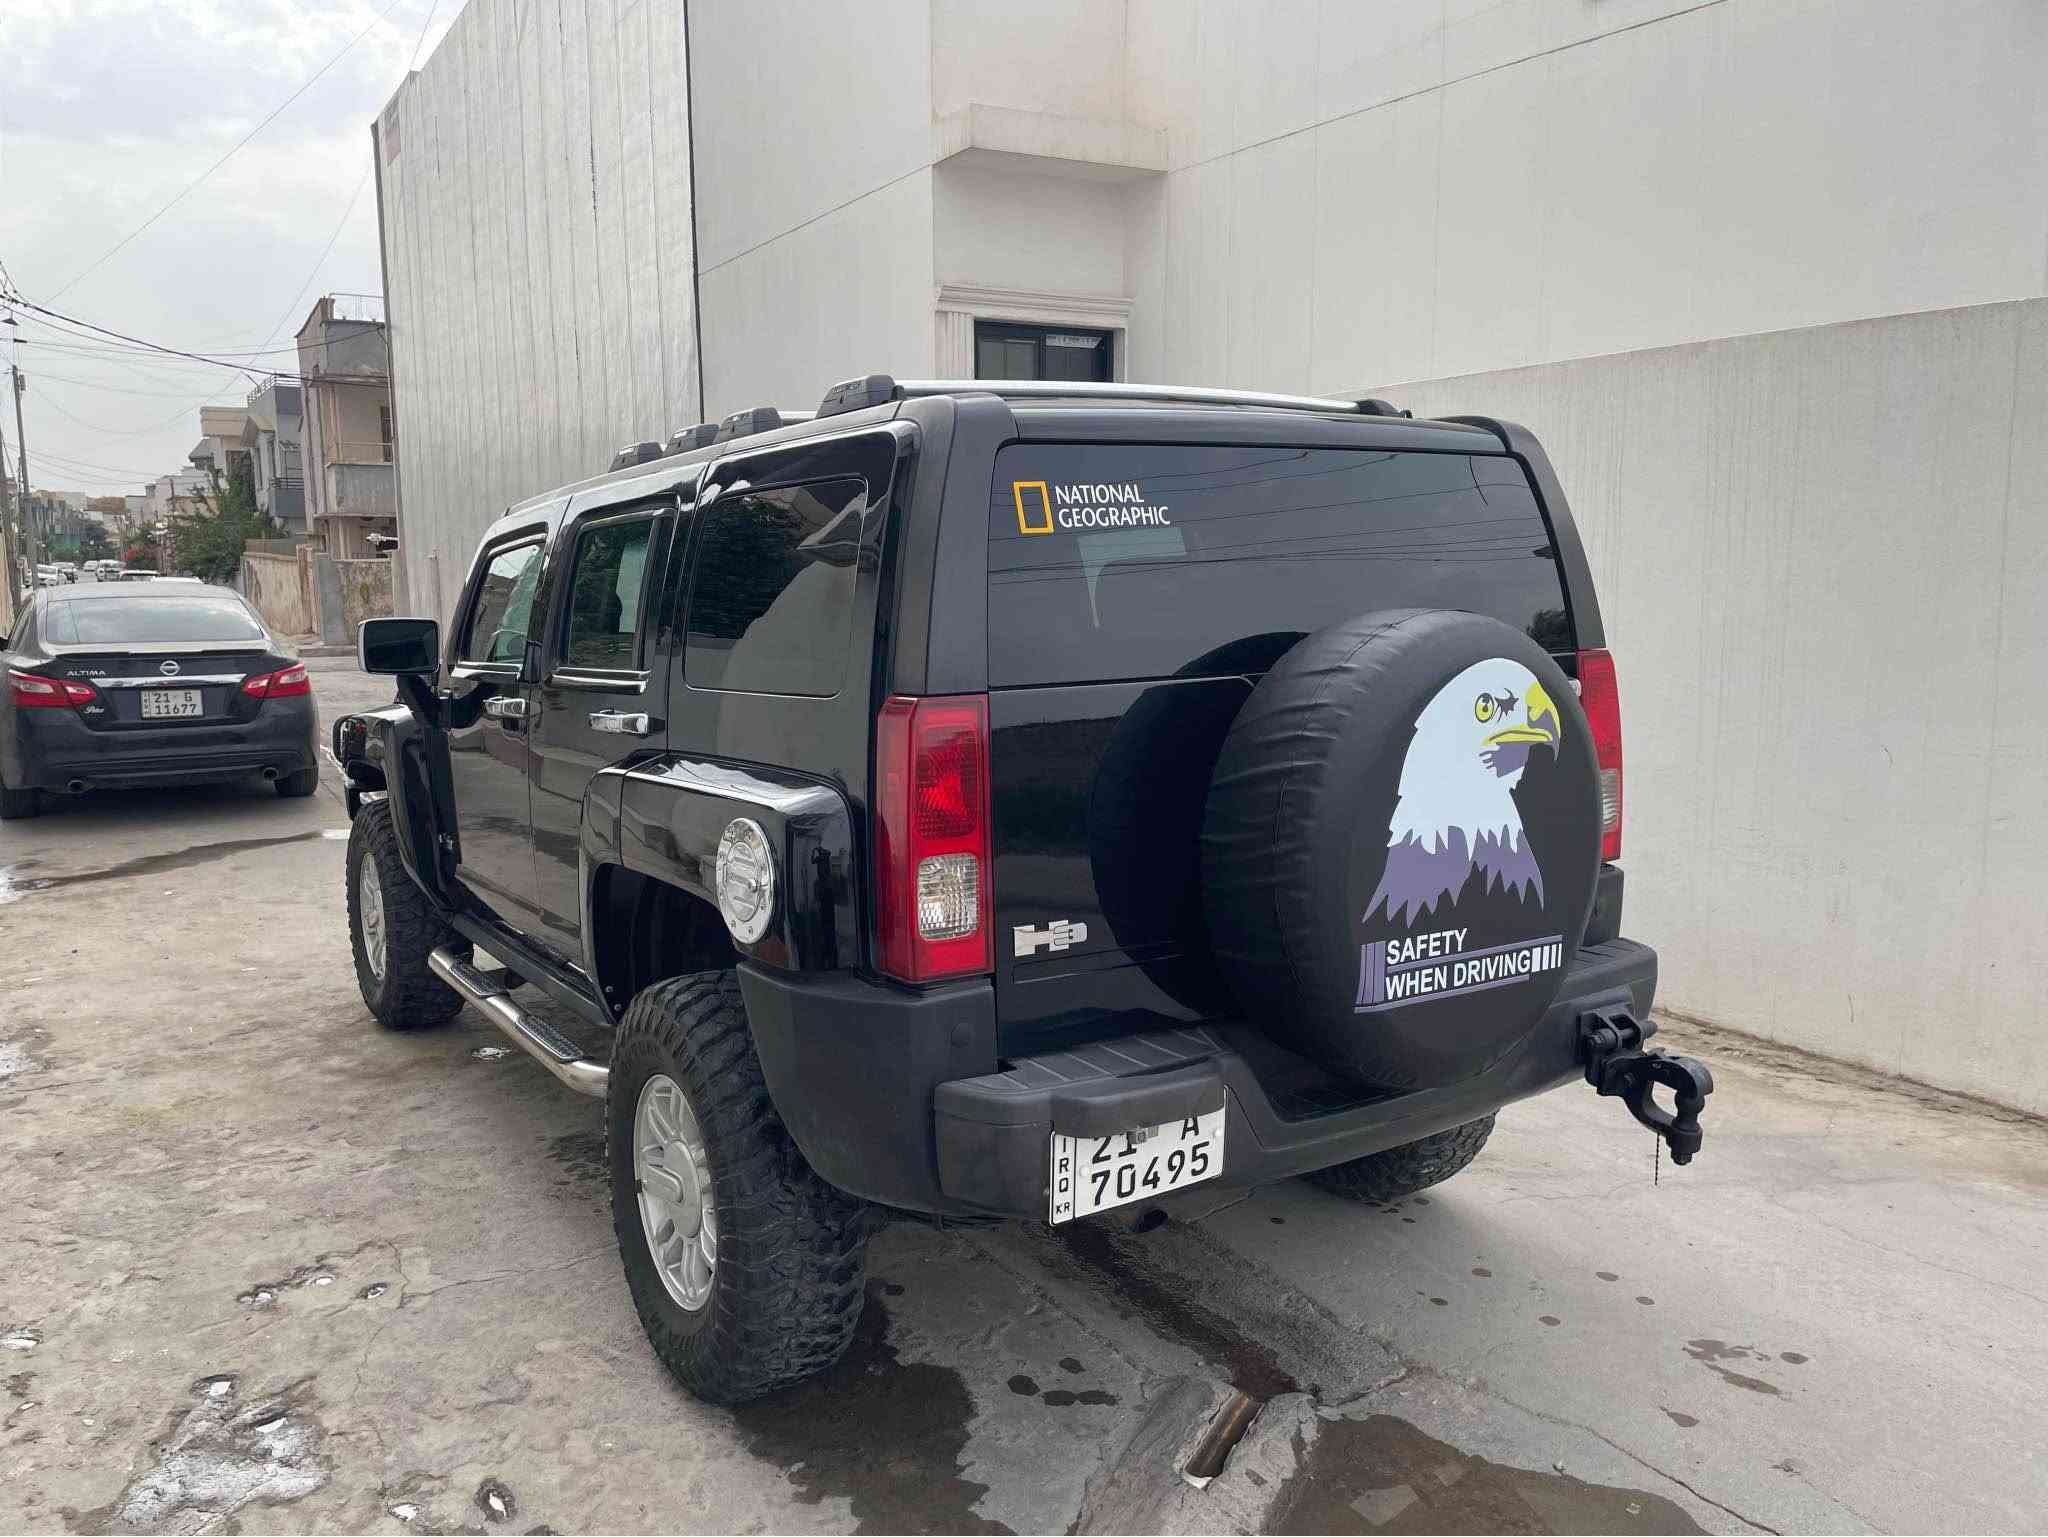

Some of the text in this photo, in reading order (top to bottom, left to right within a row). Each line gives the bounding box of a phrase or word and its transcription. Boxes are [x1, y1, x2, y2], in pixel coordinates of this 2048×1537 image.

[1055, 484, 1144, 504] NATIONAL
[1058, 506, 1171, 528] GEOGRAPHIC
[154, 692, 170, 703] 21
[155, 704, 196, 715] 11677
[1386, 928, 1467, 965] SAFETY
[1386, 950, 1531, 1000] WHEN DRIVING
[1091, 1141, 1210, 1206] 70495
[1056, 1202, 1070, 1214] KR
